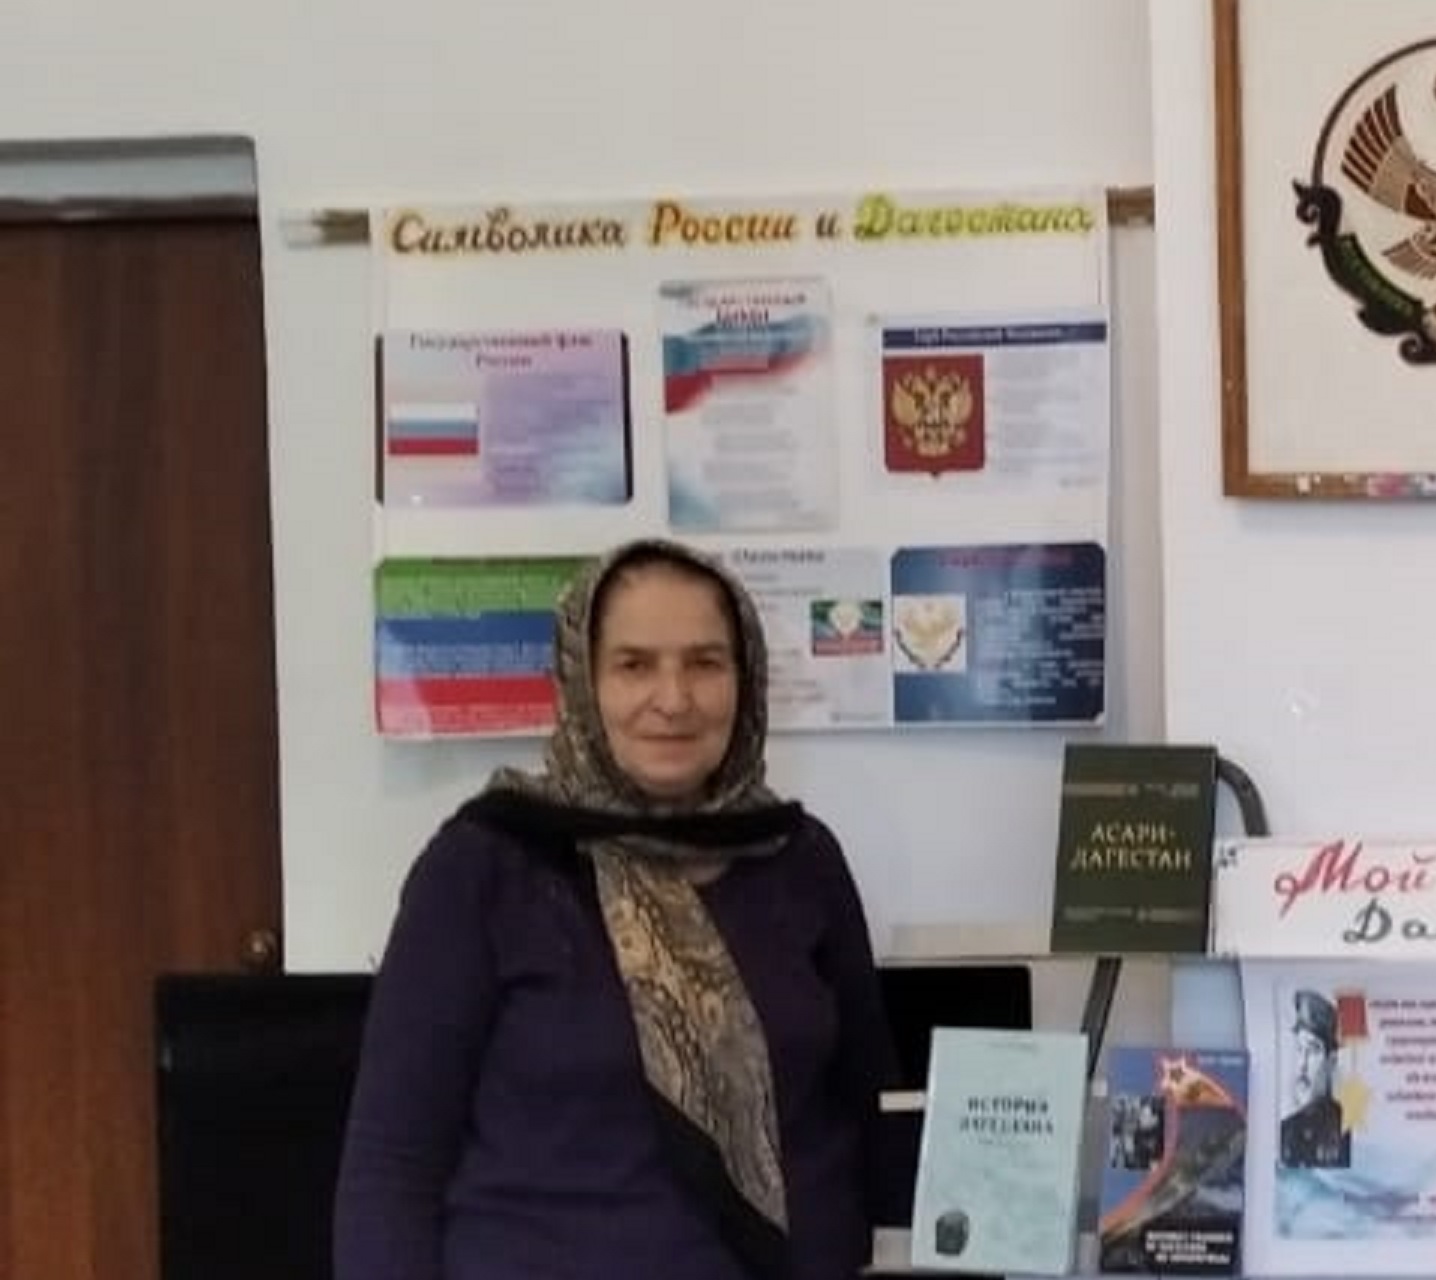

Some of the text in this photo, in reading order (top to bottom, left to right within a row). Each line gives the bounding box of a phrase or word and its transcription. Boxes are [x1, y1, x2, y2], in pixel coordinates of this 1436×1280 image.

[391, 195, 1093, 253] Символика России и Дагестана
[1070, 847, 1192, 870] ДАГЕСТАН
